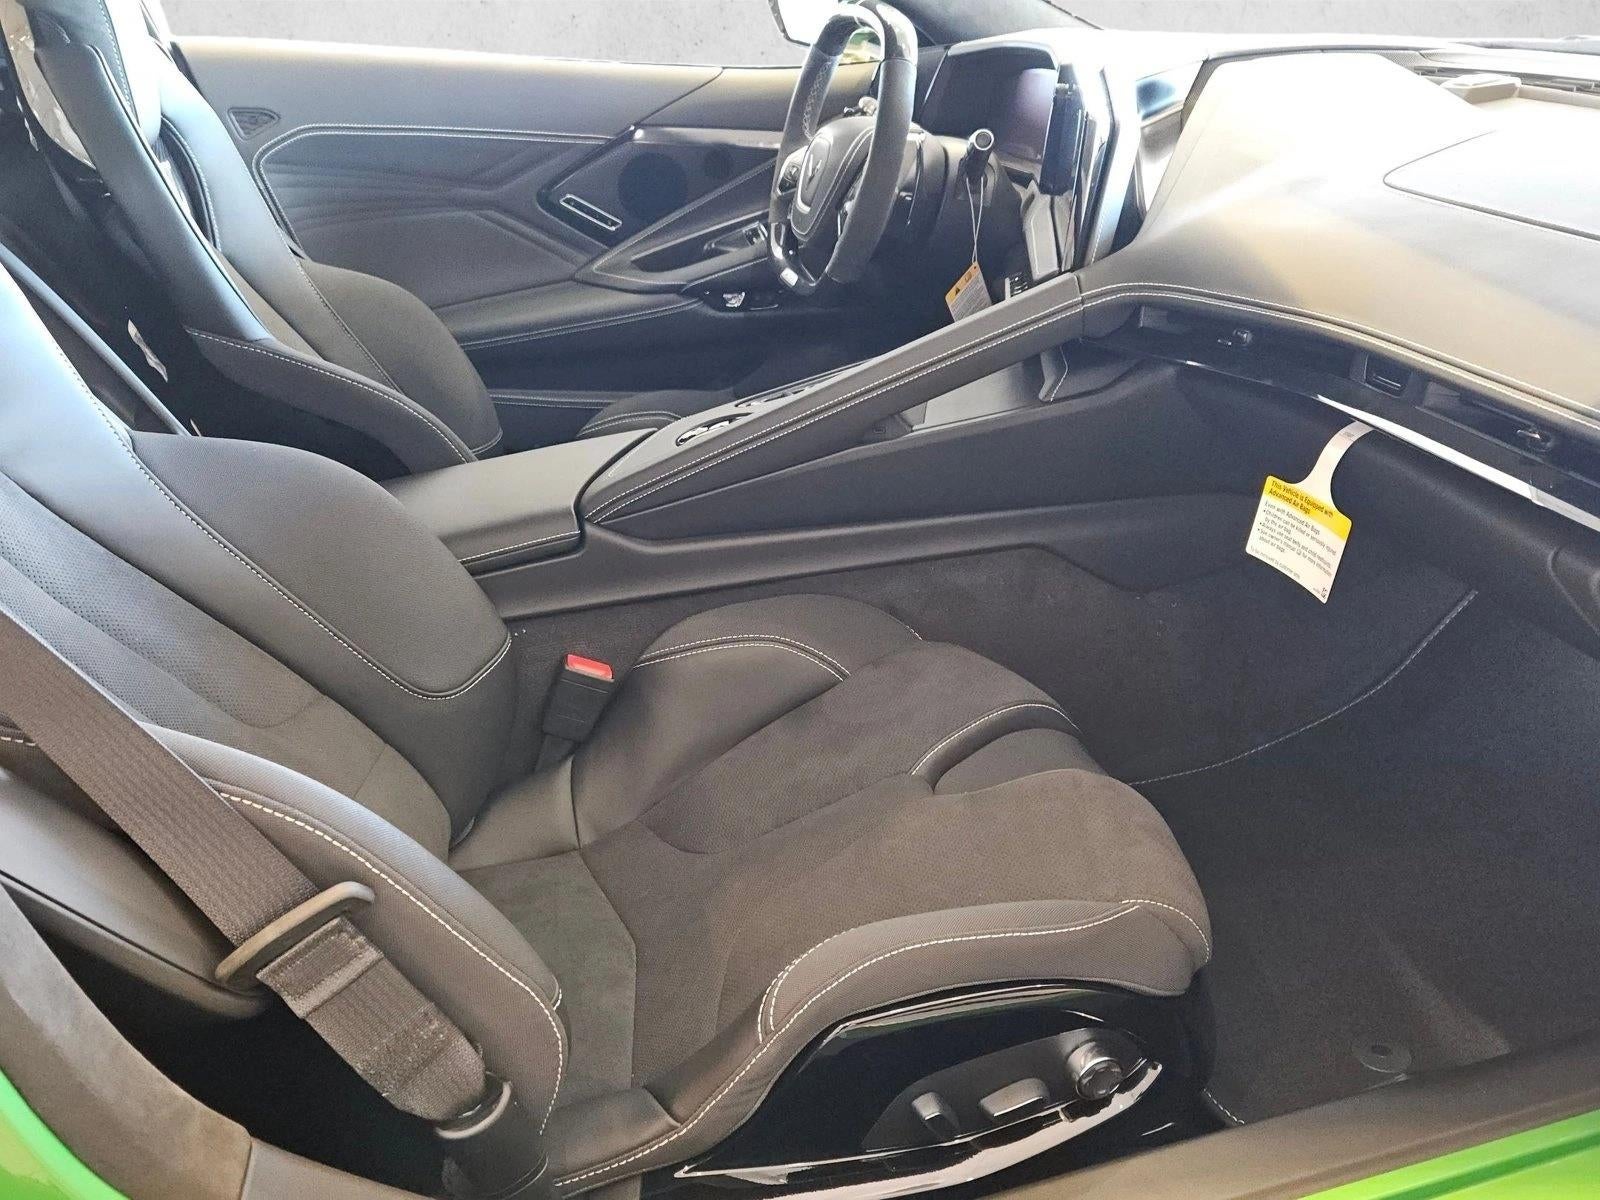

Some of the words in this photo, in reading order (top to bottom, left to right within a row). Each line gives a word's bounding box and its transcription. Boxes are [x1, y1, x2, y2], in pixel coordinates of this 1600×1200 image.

[1269, 487, 1292, 503] Advanced
[1299, 503, 1311, 515] Bags
[1271, 480, 1282, 489] This
[1282, 485, 1299, 498] Vehicle
[1304, 497, 1324, 513] Equipped
[1323, 508, 1334, 518] with
[1266, 509, 1282, 522] Children
[1286, 511, 1304, 525] Advanced
